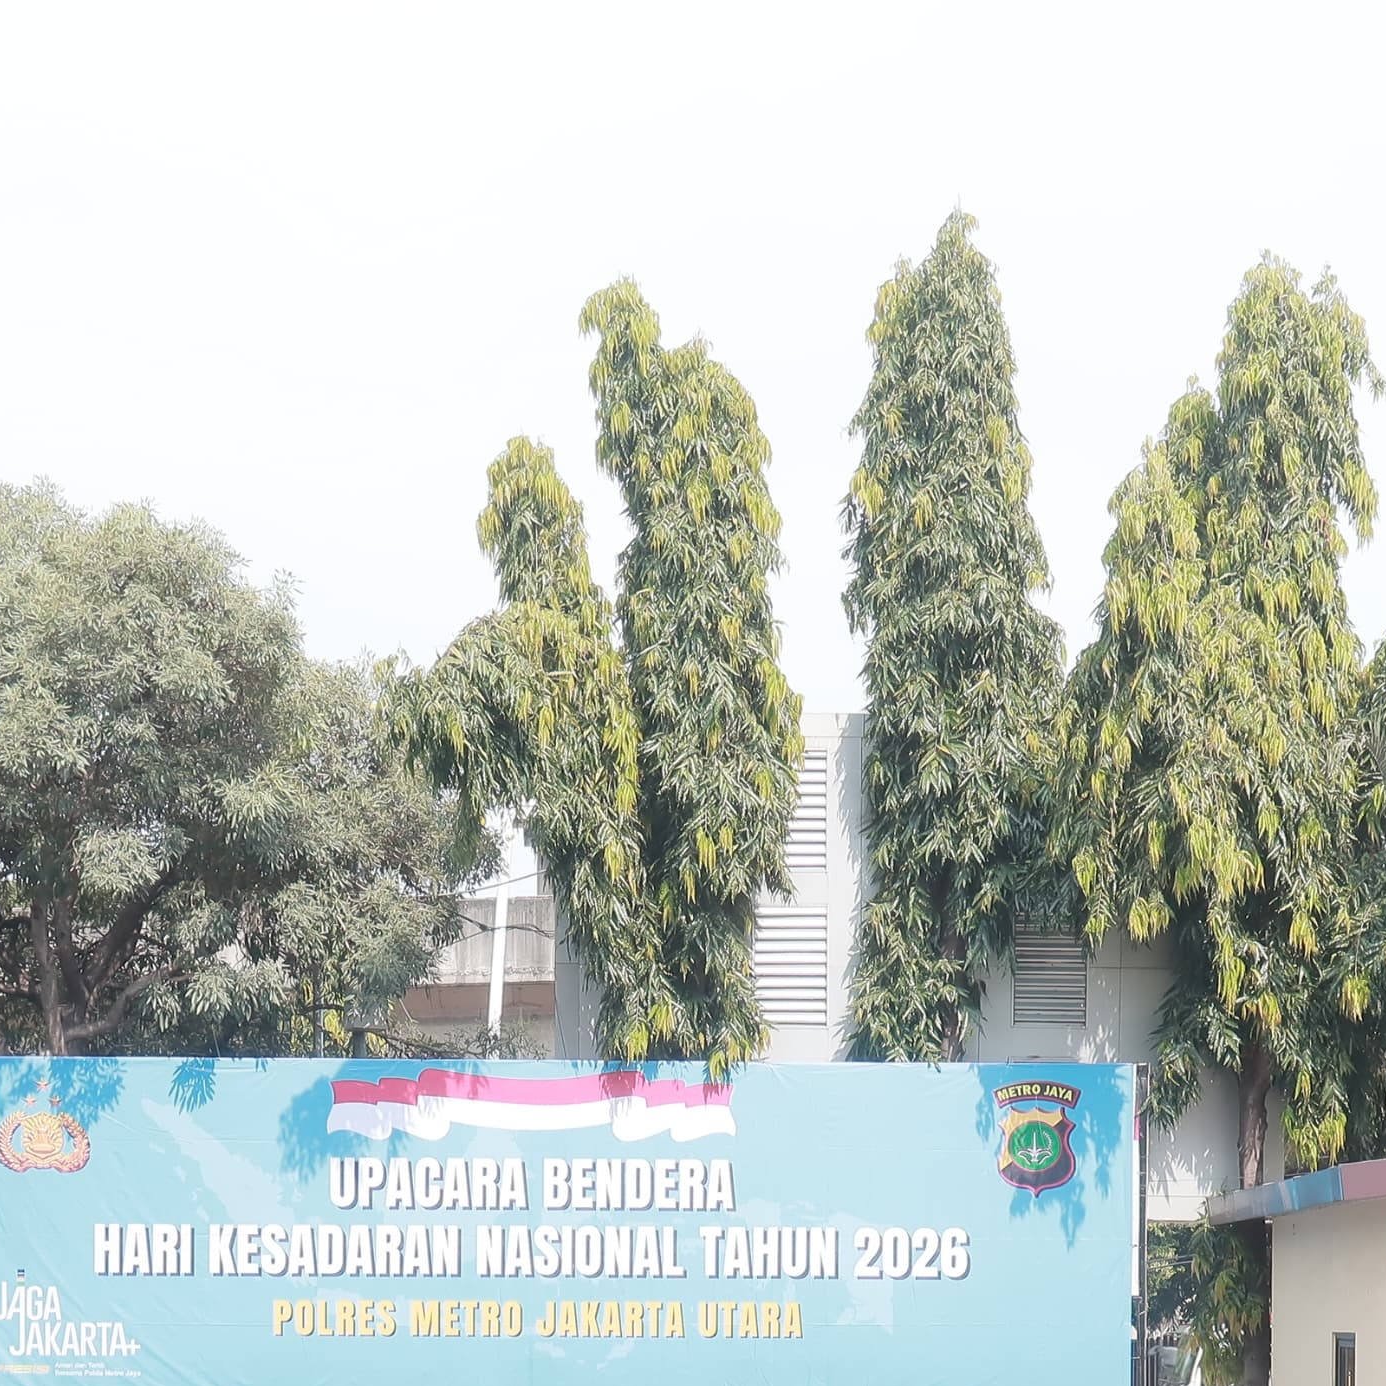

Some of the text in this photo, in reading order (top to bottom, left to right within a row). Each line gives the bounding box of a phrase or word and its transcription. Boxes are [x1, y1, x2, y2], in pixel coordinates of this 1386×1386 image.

[996, 1084, 1074, 1101] METRO JAYA
[329, 1156, 736, 1212] UPACARA BENDERA
[93, 1223, 970, 1280] HARI KESADARAN NASIONAL TAHUN 2026
[272, 1299, 803, 1339] POLRES METRO JAKARTA UTARA
